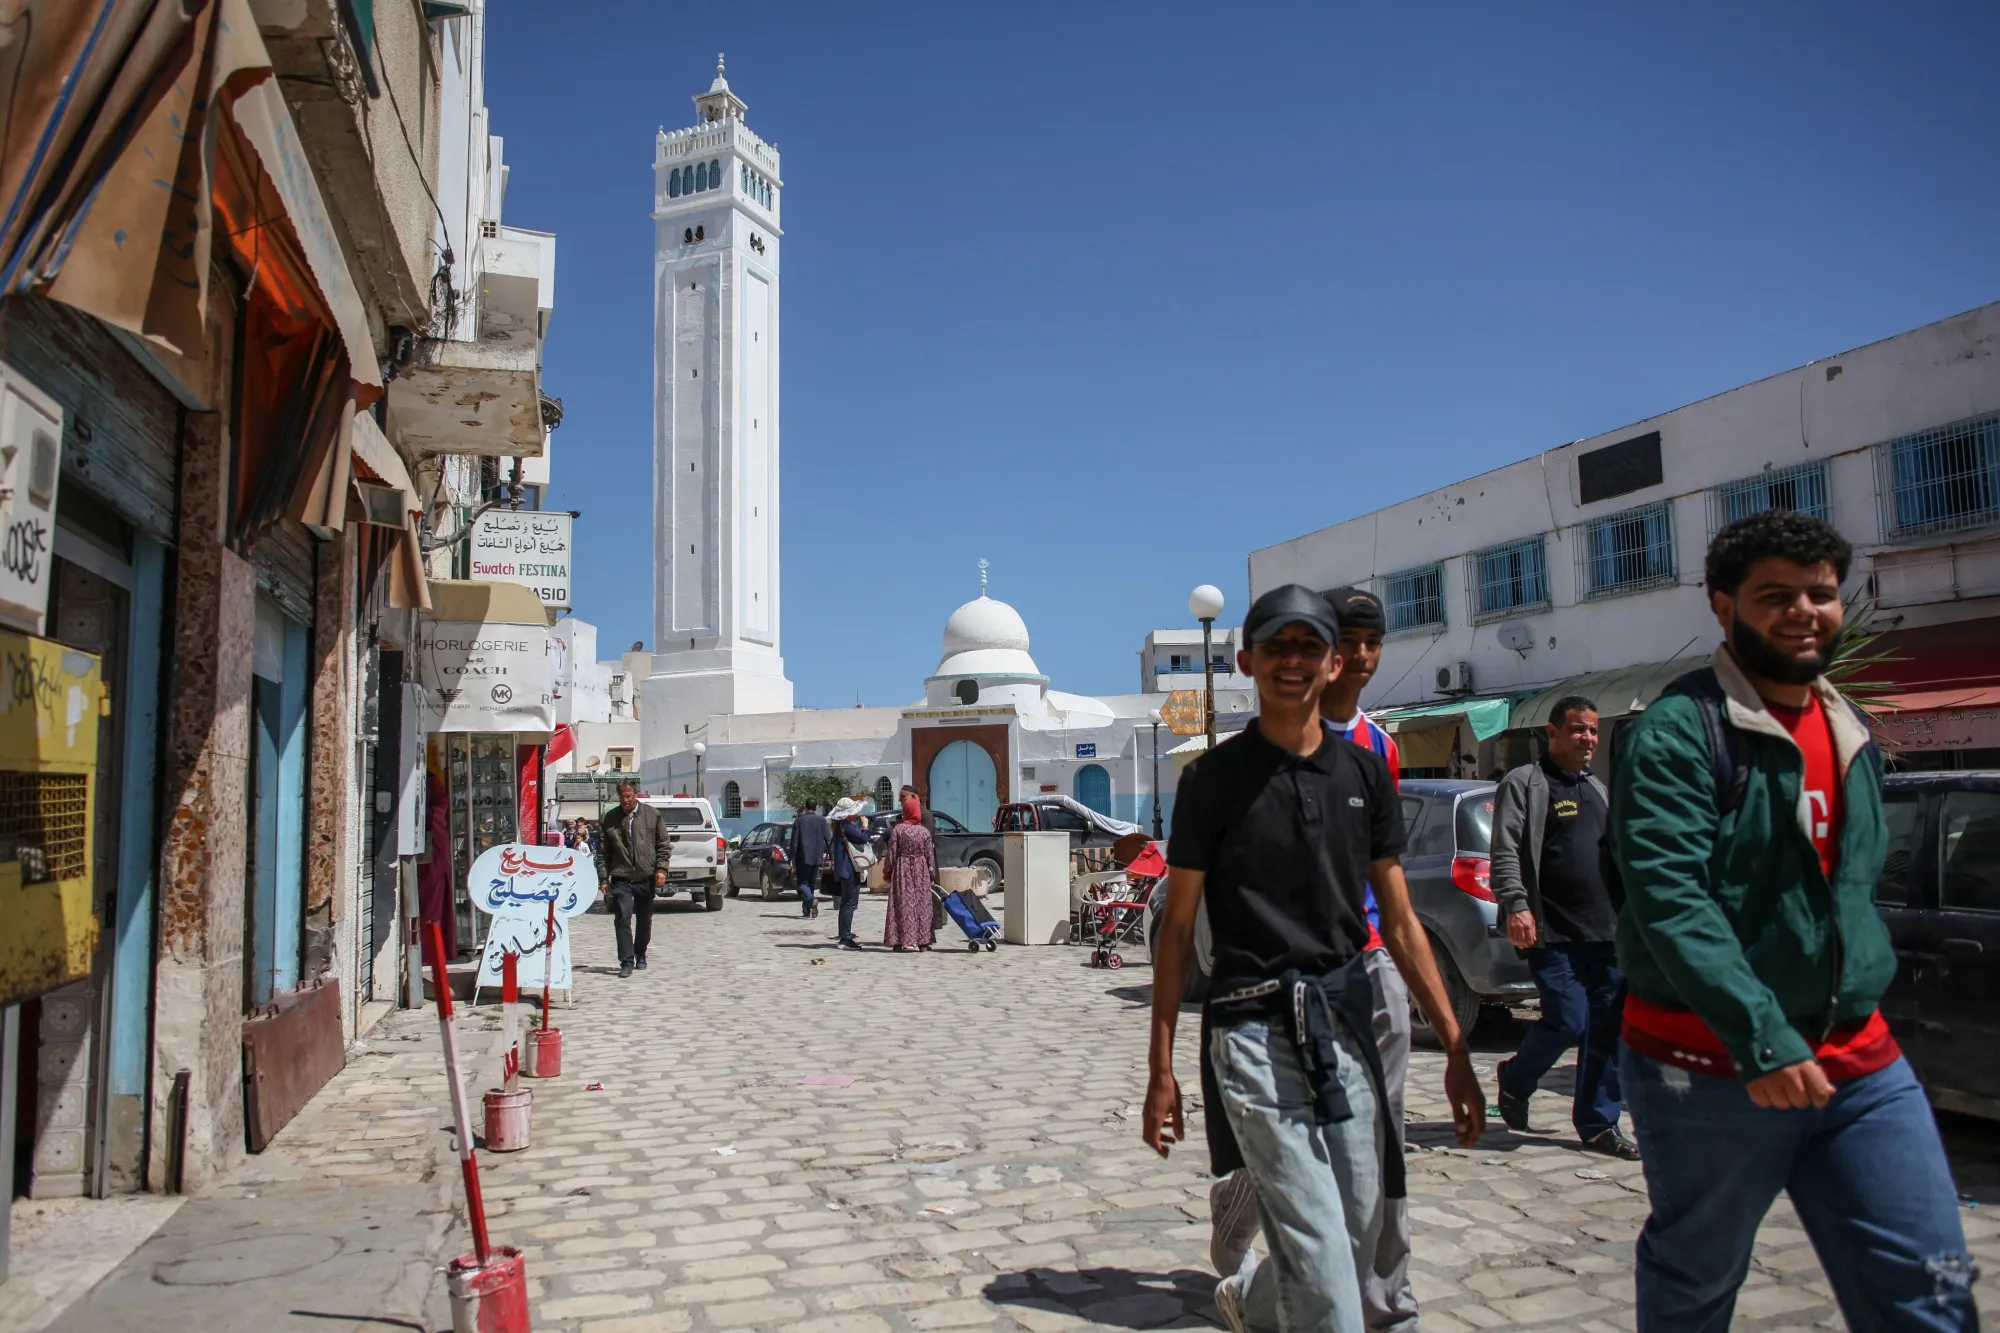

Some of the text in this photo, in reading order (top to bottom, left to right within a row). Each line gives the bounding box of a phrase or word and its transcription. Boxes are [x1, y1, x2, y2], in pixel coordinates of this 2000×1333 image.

[473, 561, 567, 577] Swatch FESTINA
[527, 587, 566, 601] ASIO
[423, 640, 529, 652] HORLOGERIE
[443, 666, 507, 675] COACH
[1948, 710, 1964, 720] الله
[501, 848, 574, 876] بيع
[489, 876, 563, 907] تصليح
